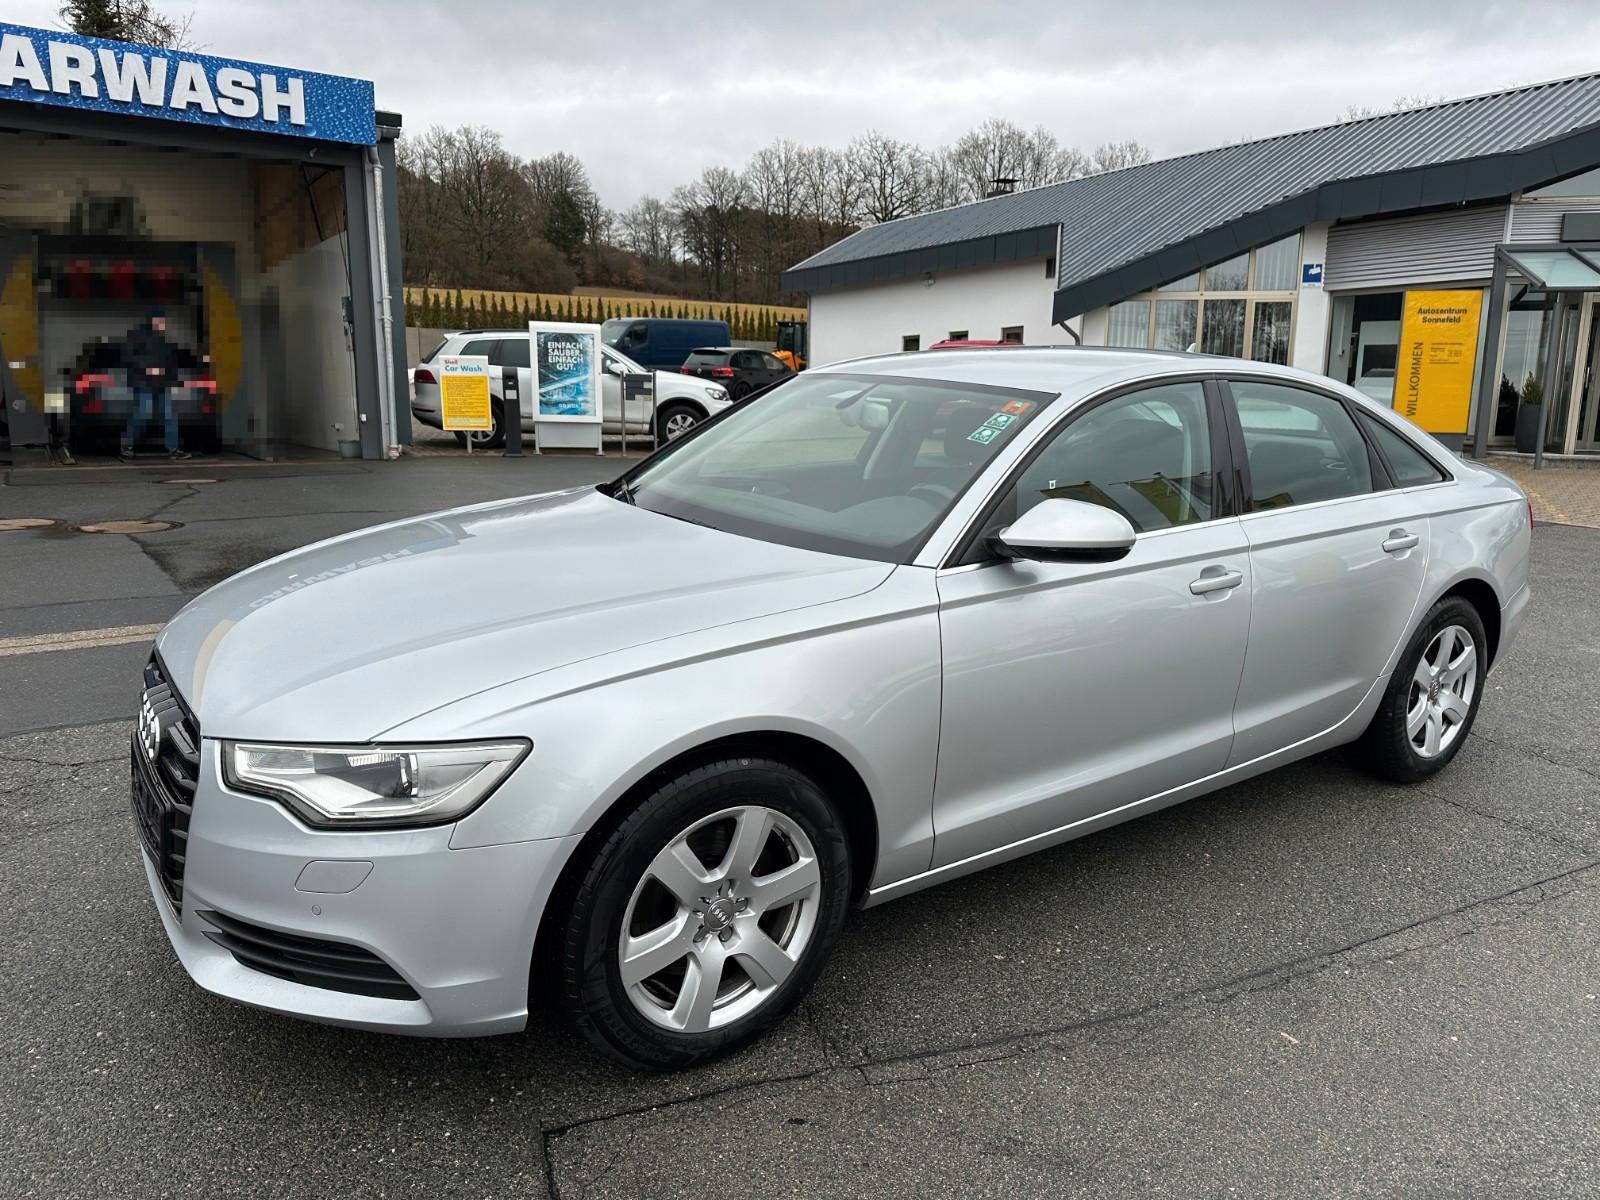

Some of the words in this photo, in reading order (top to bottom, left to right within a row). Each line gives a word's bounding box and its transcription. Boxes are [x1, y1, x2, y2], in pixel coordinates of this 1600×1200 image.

[1417, 307, 1468, 315] Autozentrum
[547, 341, 583, 350] EINFACH
[548, 356, 584, 364] EINFACH
[460, 364, 482, 372] Wash
[556, 363, 576, 371] GUT.
[1406, 342, 1424, 416] WILLKOMMEN
